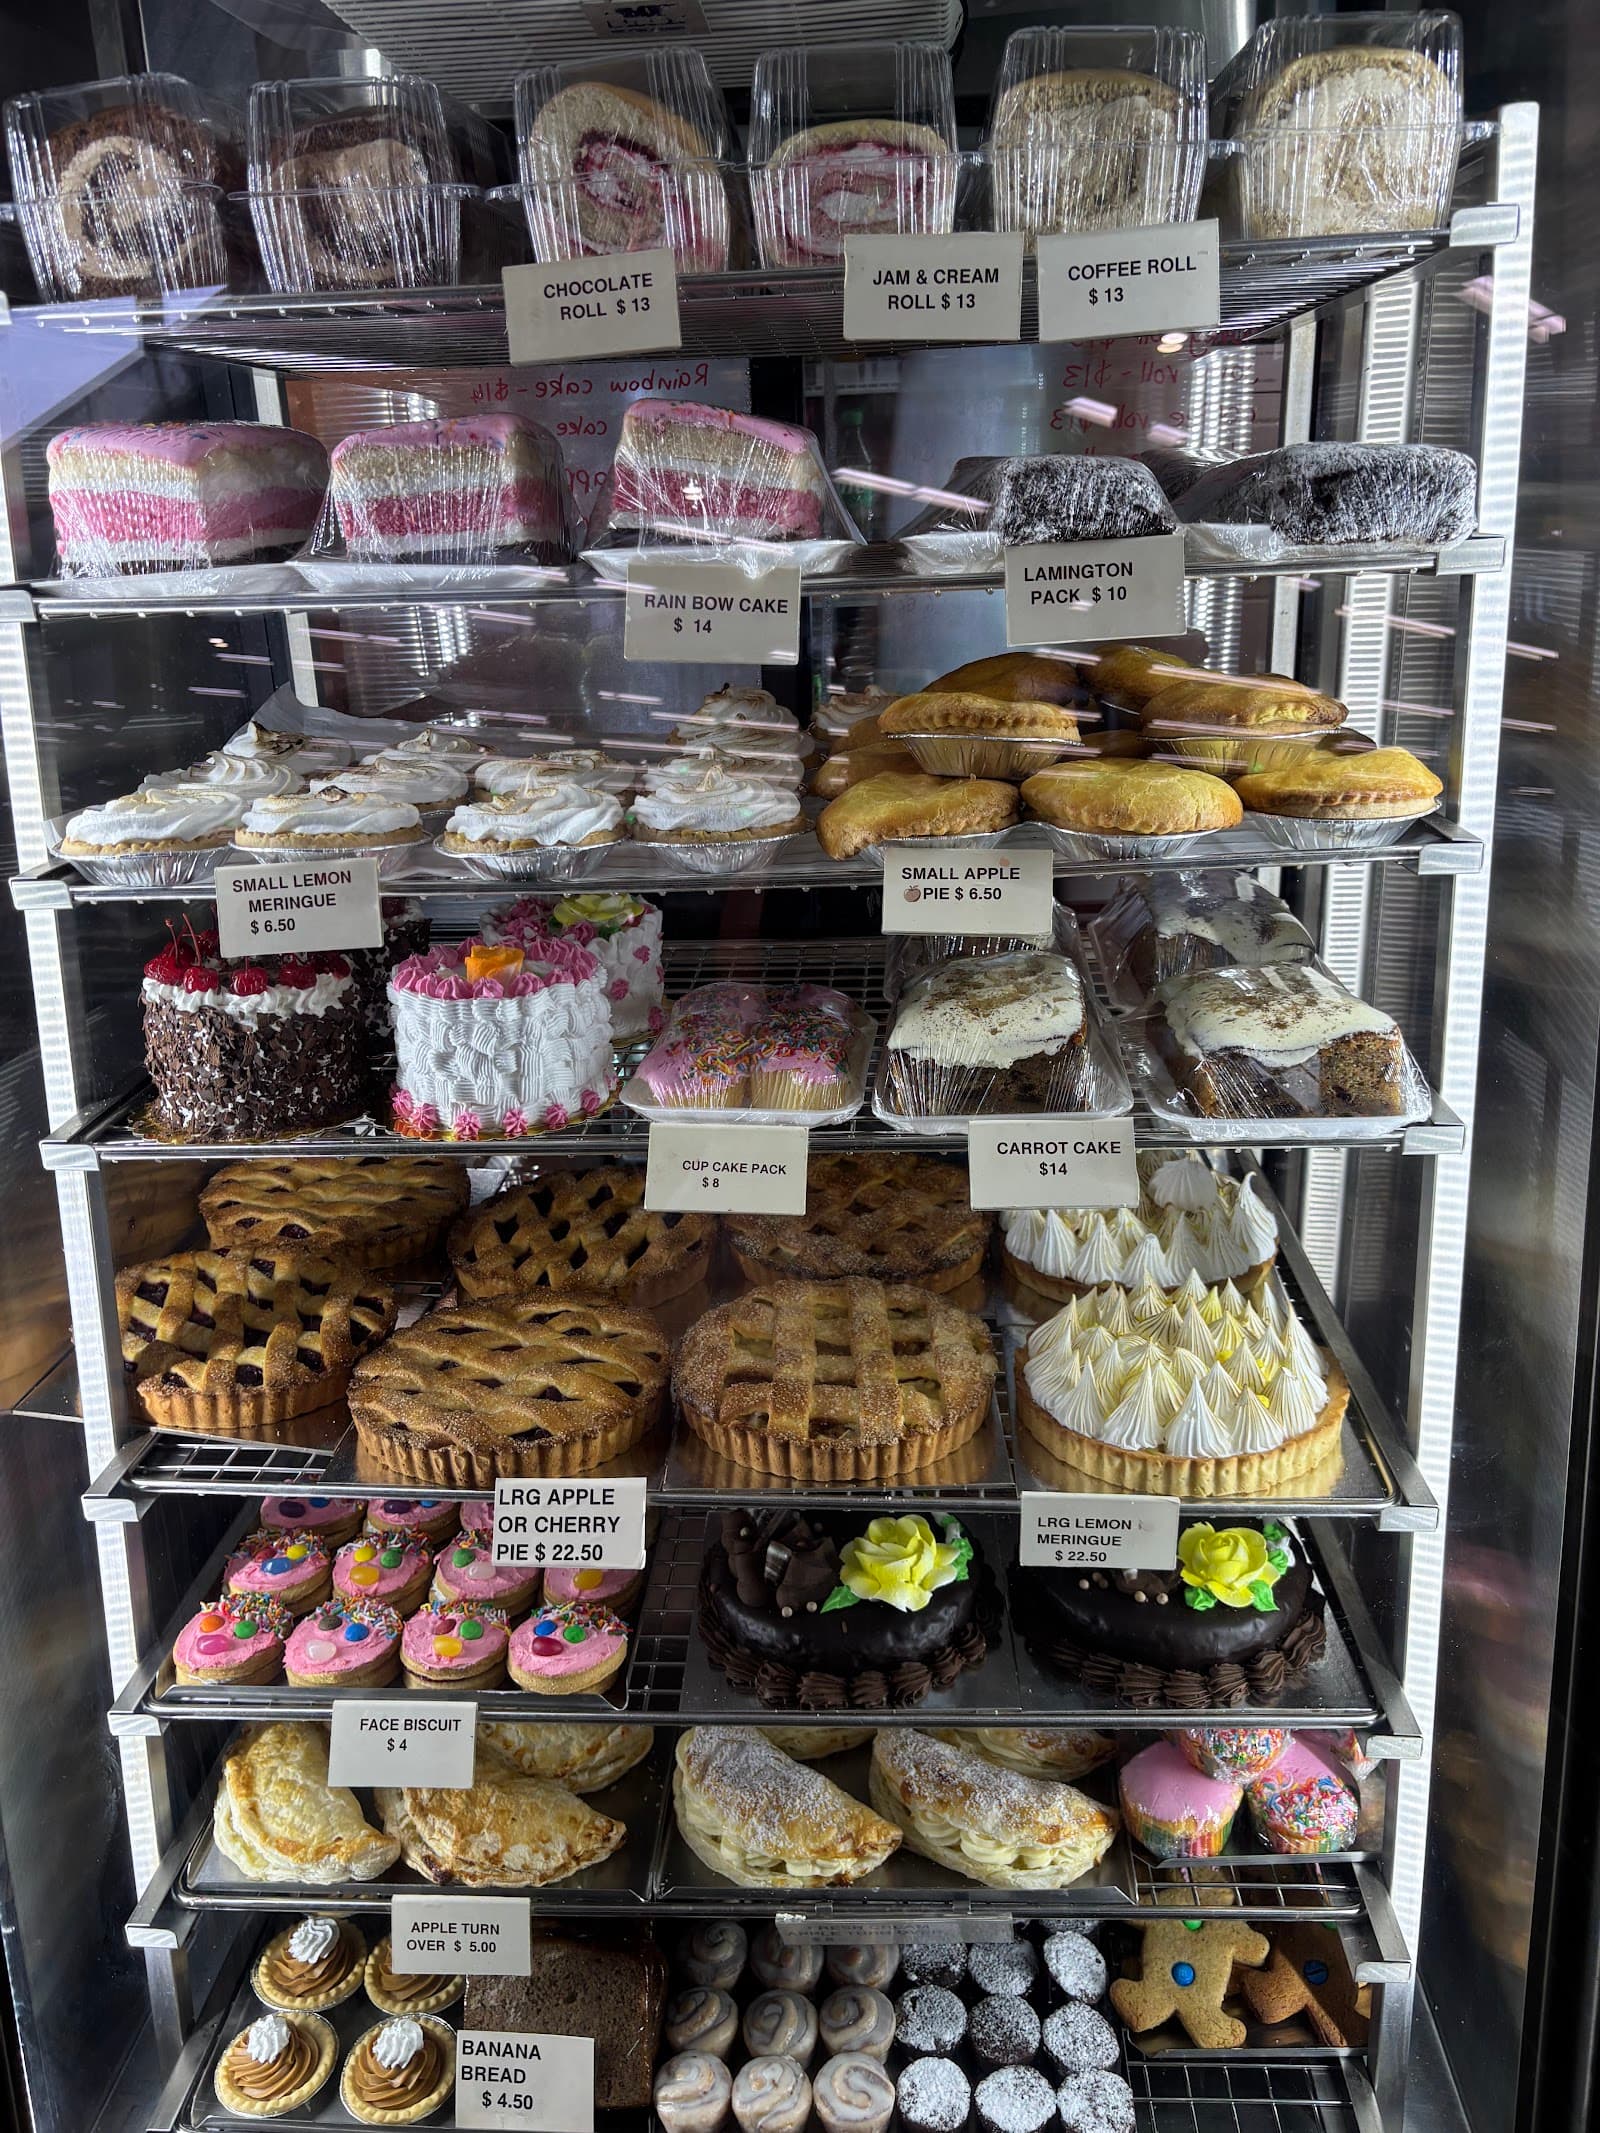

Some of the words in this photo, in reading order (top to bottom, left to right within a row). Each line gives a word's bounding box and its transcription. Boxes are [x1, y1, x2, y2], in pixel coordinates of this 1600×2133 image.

[872, 269, 910, 285] JAM
[916, 269, 928, 285] &
[933, 268, 999, 284] CREAM
[1068, 260, 1142, 281] COFFEE
[1147, 255, 1197, 275] ROLL
[543, 273, 653, 299] CHOCOLATE
[888, 294, 936, 310] ROLL
[941, 292, 951, 311] $
[956, 293, 976, 309] 13
[1088, 287, 1098, 306] $
[1104, 287, 1124, 303] 13
[560, 302, 607, 321] ROLL
[616, 299, 626, 316] $
[631, 297, 650, 313] 13
[1024, 561, 1133, 582] LAMINGTON
[644, 594, 686, 609] RAIN
[692, 596, 734, 612] BOW
[739, 597, 789, 614] CAKE
[1031, 588, 1081, 605] PACK
[1092, 586, 1102, 604] $
[1107, 586, 1127, 601] 10
[673, 616, 683, 633] $
[693, 619, 712, 634] 14
[232, 876, 289, 893] SMALL
[293, 870, 352, 888] LEMON
[901, 867, 959, 880] SMALL
[964, 867, 1020, 880] APPLE
[923, 887, 950, 900] PIE
[954, 886, 964, 901] $
[969, 887, 1002, 900] 6.50
[249, 893, 337, 913] MERINGUE
[250, 920, 259, 935] $
[264, 918, 296, 933] 6.50
[997, 1141, 1069, 1155] CARROT
[1073, 1141, 1121, 1154] CAKE
[682, 1160, 709, 1172] CUP
[712, 1161, 748, 1173] CAKE
[751, 1163, 787, 1175] PACK
[1039, 1161, 1068, 1176] $14
[702, 1177, 709, 1188] $
[712, 1177, 719, 1188] 8
[499, 1488, 541, 1506] LRG
[547, 1488, 615, 1506] APPLE
[498, 1516, 528, 1533] OR
[534, 1516, 621, 1533] CHERRY
[1037, 1517, 1070, 1529] LRG
[1075, 1518, 1132, 1530] LEMON
[1037, 1534, 1122, 1546] MERINGUE
[496, 1543, 529, 1561] PIE
[535, 1542, 546, 1563] $
[552, 1544, 603, 1561] 22.50
[1055, 1550, 1063, 1562] $
[1067, 1551, 1107, 1562] 22.50
[360, 1718, 400, 1731] FACE
[403, 1719, 462, 1731] BISCUIT
[387, 1737, 395, 1752] $
[399, 1738, 408, 1751] 4
[410, 1922, 457, 1934] APPLE
[461, 1923, 500, 1935] TURN
[406, 1939, 446, 1951] OVER
[454, 1940, 462, 1953] $
[469, 1941, 497, 1953] 5.00
[462, 2039, 542, 2060] BANANA
[461, 2065, 527, 2084] BREAD
[482, 2090, 492, 2109] $
[497, 2092, 534, 2110] 4.50
